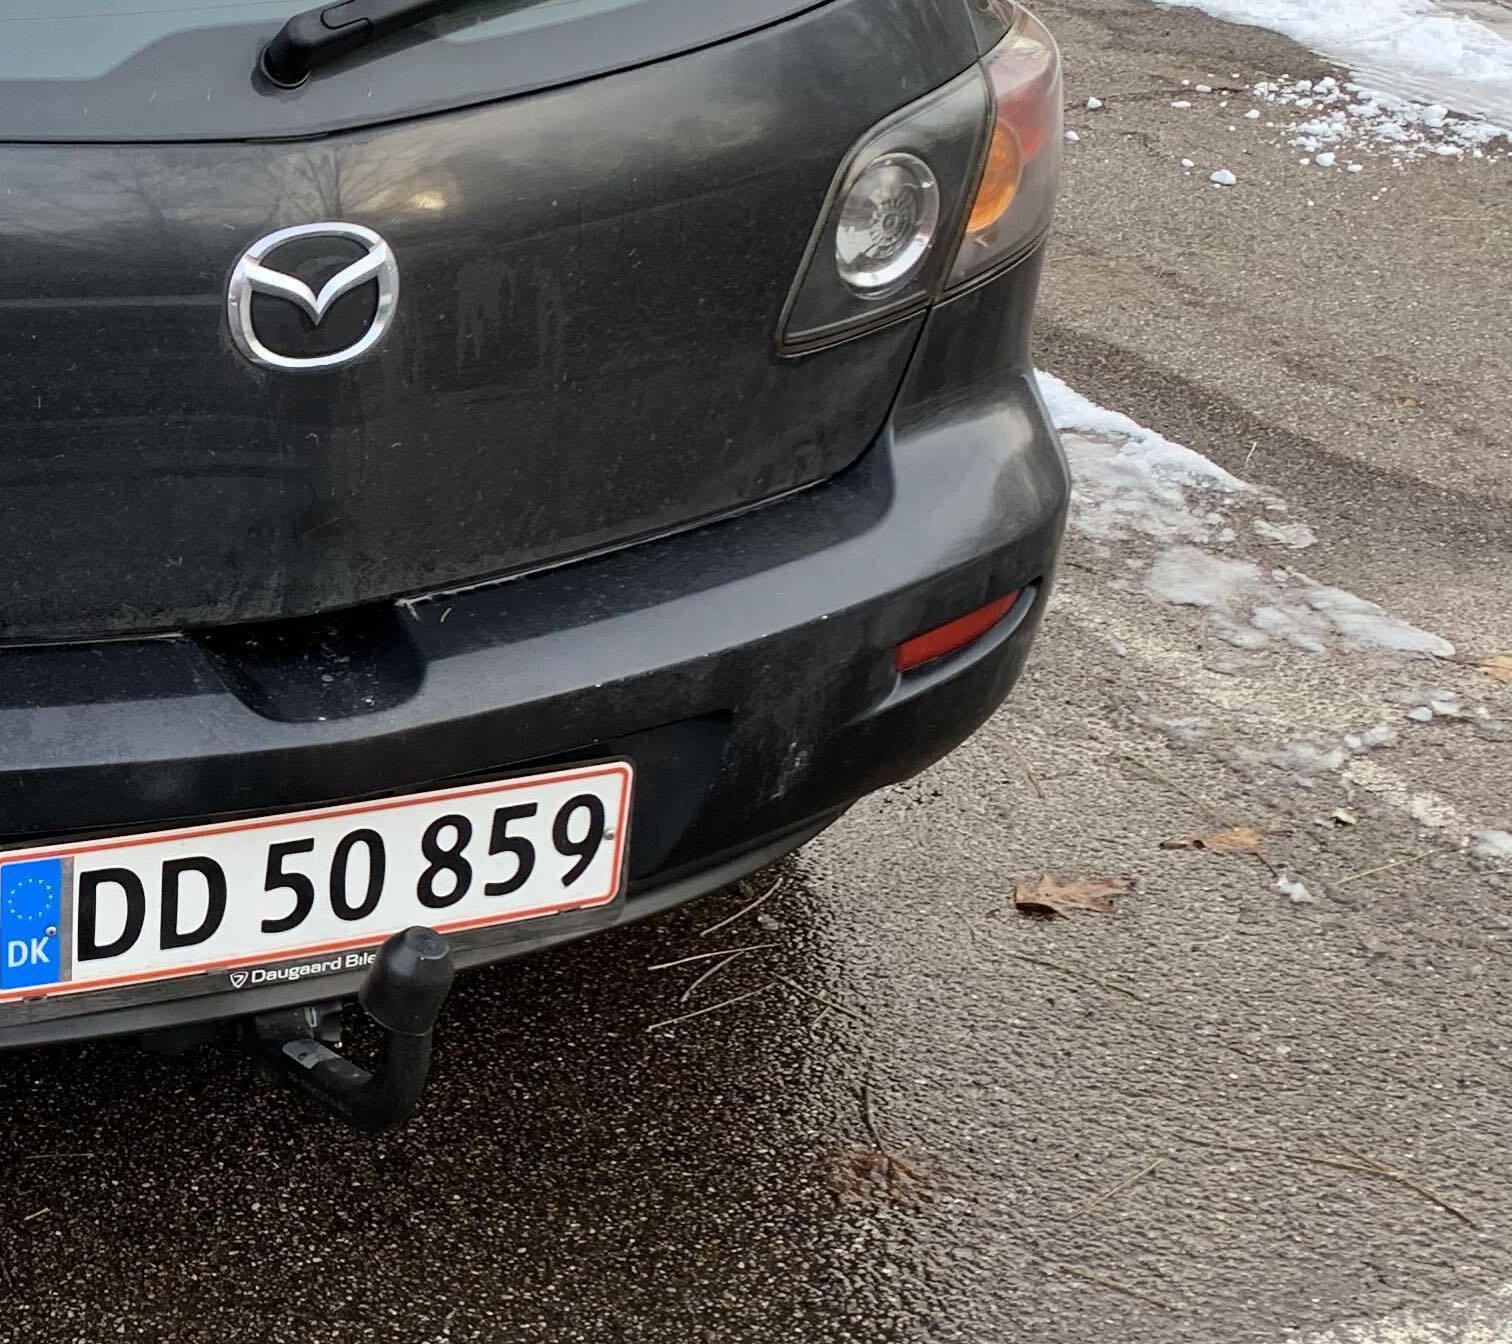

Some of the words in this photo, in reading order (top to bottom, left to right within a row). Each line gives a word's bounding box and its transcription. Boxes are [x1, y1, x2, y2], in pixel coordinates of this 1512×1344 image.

[77, 855, 228, 962] DD
[260, 828, 386, 934] 50
[416, 793, 606, 910] 859
[7, 936, 50, 968] DK
[250, 956, 342, 984] Daugaard
[345, 952, 378, 968] Bile
